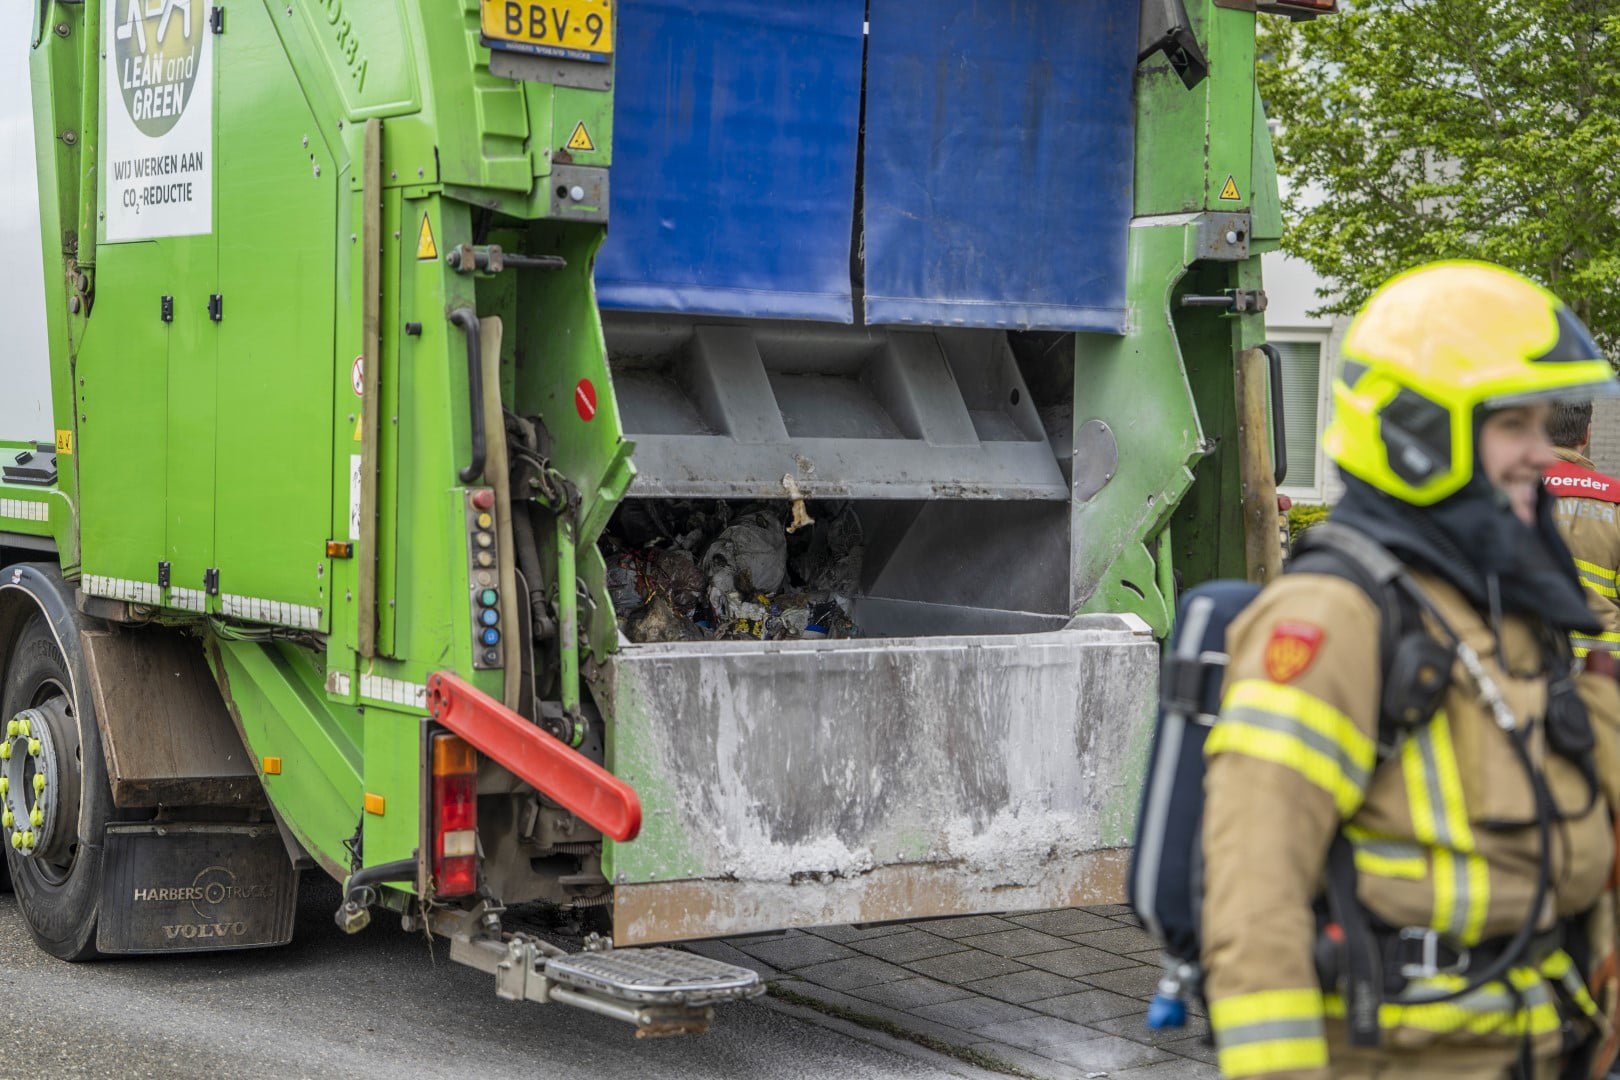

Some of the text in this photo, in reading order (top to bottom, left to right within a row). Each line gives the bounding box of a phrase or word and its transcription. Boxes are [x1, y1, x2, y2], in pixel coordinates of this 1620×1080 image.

[505, 1, 604, 47] BBV-9
[318, 0, 369, 94] ORBA
[124, 46, 194, 90] LEAN and
[133, 85, 185, 121] GREEN
[114, 151, 203, 181] WIJ WERKEN AAN
[134, 886, 204, 901] HARBERS
[163, 921, 248, 939] VOLVO
